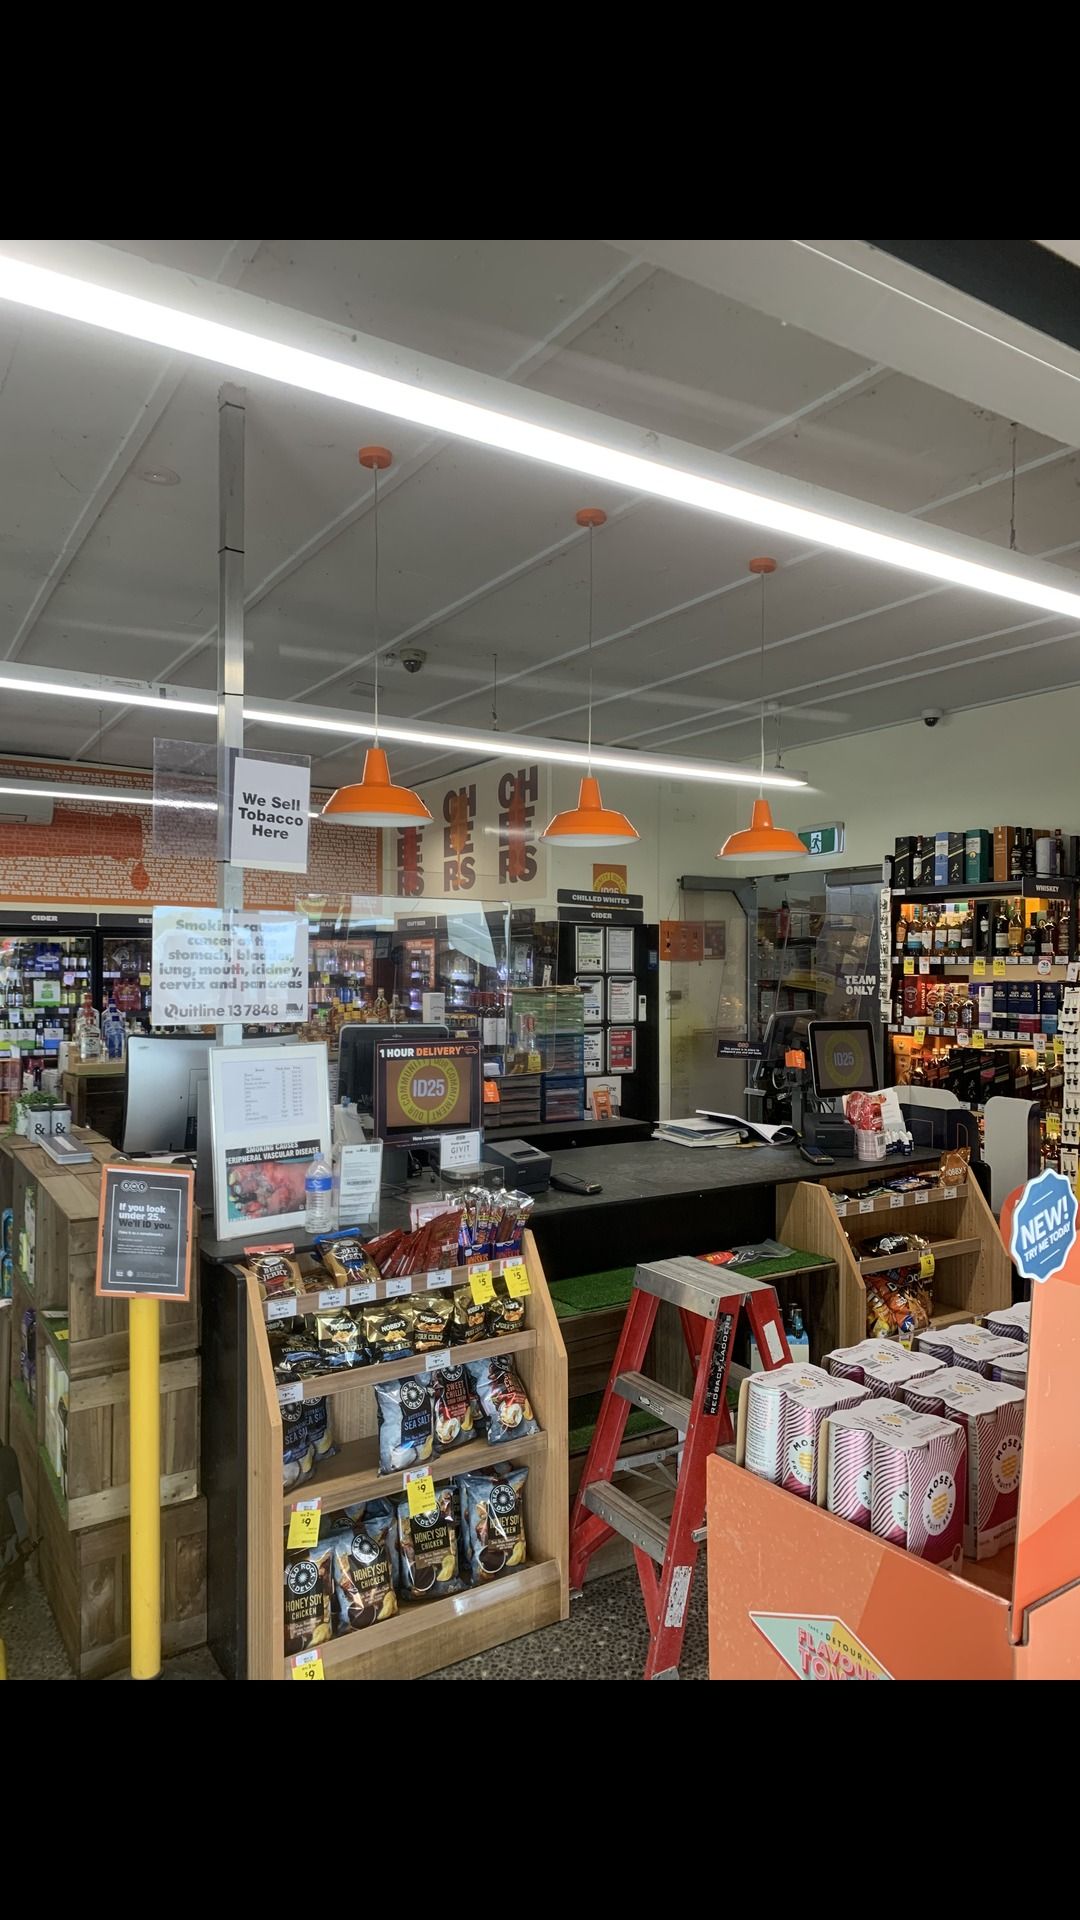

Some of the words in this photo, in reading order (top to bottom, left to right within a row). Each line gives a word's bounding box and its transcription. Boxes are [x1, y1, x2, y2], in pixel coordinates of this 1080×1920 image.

[242, 792, 266, 806] We
[271, 796, 300, 811] Sell
[238, 807, 303, 826] Tobacco
[252, 824, 288, 839] Here
[572, 894, 602, 902] CHILLED
[176, 920, 239, 935] Smoking
[168, 949, 232, 962] stomach,
[160, 963, 196, 978] lung,
[199, 963, 249, 975] mouth,
[252, 964, 302, 977] kidney,
[160, 979, 205, 990] cervix
[209, 978, 237, 989] and
[240, 980, 302, 991] pancreas
[844, 975, 876, 985] TEAM
[845, 986, 875, 996] ONLY
[228, 1004, 279, 1016] 137848
[379, 1049, 385, 1058] 1
[386, 1048, 414, 1058] HOUR
[833, 1052, 854, 1066] ID25
[413, 1078, 446, 1097] ID25
[34, 1123, 45, 1135] &
[55, 1122, 66, 1134] &
[246, 1145, 274, 1153] SMOKING
[275, 1142, 299, 1150] CAUSES
[263, 1150, 294, 1160] VASCULAR
[295, 1147, 319, 1155] DISEASE
[451, 1145, 470, 1154] GIVIT
[119, 1202, 126, 1210] If
[147, 1205, 166, 1213] look
[119, 1211, 145, 1220] under
[147, 1213, 161, 1221] 25.
[119, 1220, 140, 1228] We'll
[154, 1222, 173, 1230] you.
[1021, 1195, 1068, 1250] NEW!
[1024, 1246, 1038, 1262] TRY
[1039, 1237, 1050, 1252] ME
[1050, 1221, 1070, 1244] TODAY
[341, 1254, 362, 1262] JERKY
[263, 1264, 284, 1274] BEEF
[262, 1270, 288, 1281] JERKY
[381, 1320, 406, 1332] NOBBY'S
[720, 1315, 732, 1362] LADDERS
[446, 1380, 464, 1390] SWEET
[710, 1364, 724, 1414] REDBACK
[409, 1399, 422, 1407] DELI
[404, 1419, 417, 1430] SEA
[418, 1414, 430, 1428] SALT
[285, 1433, 298, 1444] SEA
[996, 1439, 1022, 1460] MOSEY
[927, 1475, 952, 1499] MOSEY
[492, 1489, 500, 1503] RED
[500, 1486, 515, 1500] ROCK
[496, 1504, 513, 1512] DELI
[302, 1518, 311, 1527] $9
[420, 1516, 437, 1526] DELI
[414, 1529, 434, 1543] HONEY
[434, 1526, 447, 1537] SOY
[421, 1541, 444, 1551] CHICKEN
[290, 1566, 299, 1584] RED
[301, 1563, 317, 1579] ROCK
[353, 1565, 376, 1581] HONEY
[376, 1561, 388, 1576] SOY
[295, 1582, 311, 1594] DELI
[361, 1576, 385, 1589] CHICKEN
[286, 1595, 309, 1612] HONEY
[310, 1593, 322, 1607] SOY
[291, 1606, 317, 1620] CHICKEN
[825, 1633, 862, 1659] DETOUR
[305, 1670, 315, 1680] $9
